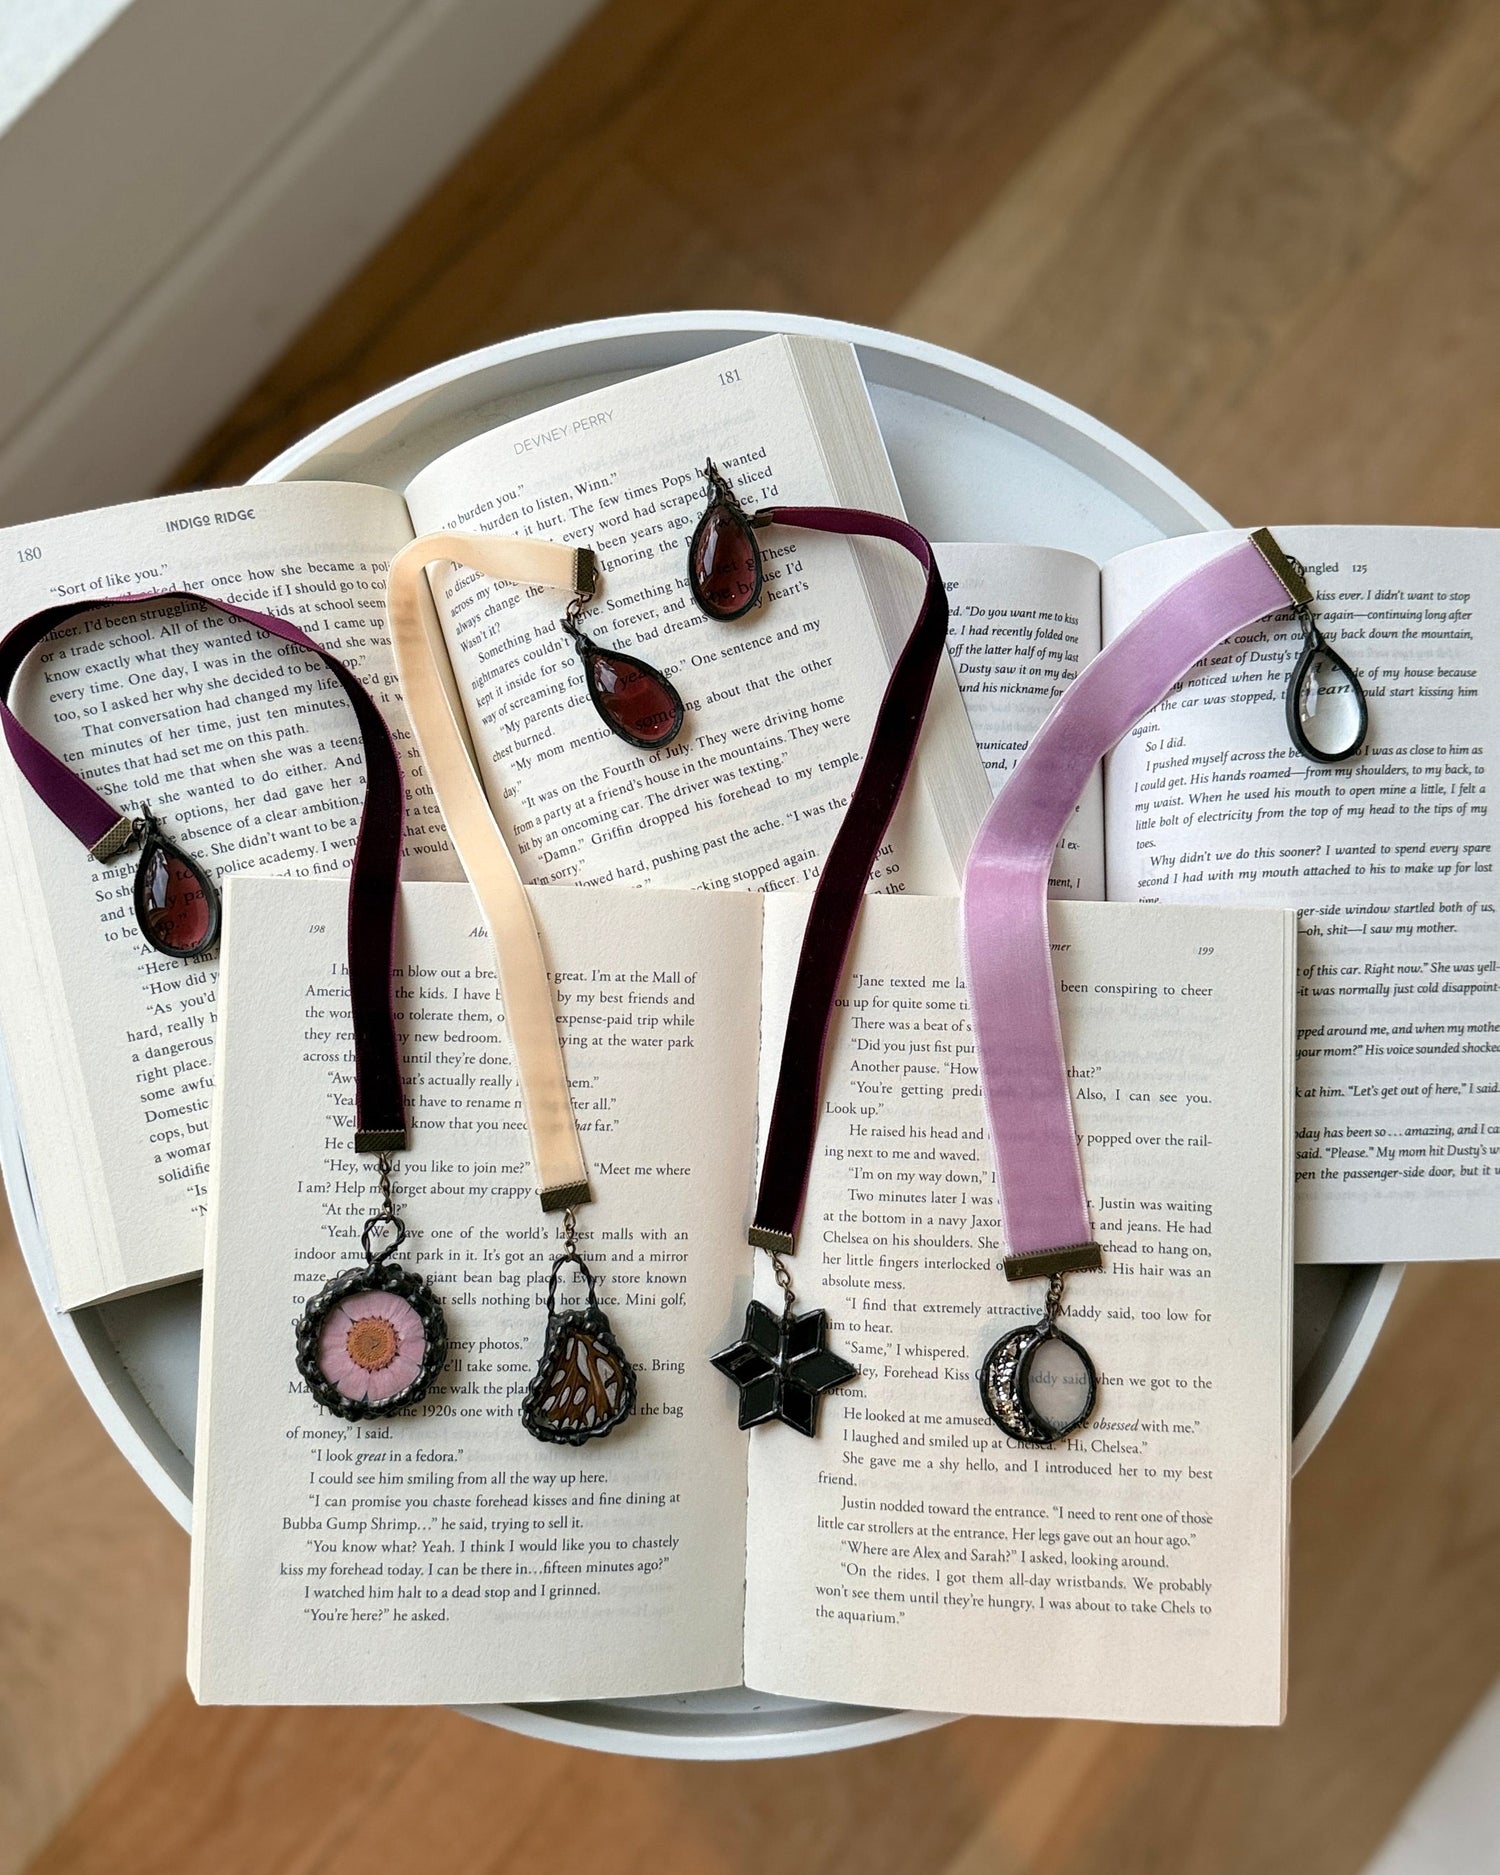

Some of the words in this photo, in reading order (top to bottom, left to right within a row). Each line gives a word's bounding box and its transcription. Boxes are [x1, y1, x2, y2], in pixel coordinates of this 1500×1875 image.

[718, 369, 742, 386] 181
[513, 425, 569, 455] DEVNEY
[572, 409, 613, 433] PERRY
[479, 511, 519, 531] burden
[521, 505, 534, 516] to
[535, 492, 573, 510] listen,
[574, 472, 617, 495] Winn.”
[568, 504, 594, 518] The
[598, 495, 619, 509] few
[624, 484, 658, 501] times
[661, 473, 691, 489] Pops
[447, 520, 457, 529] to
[457, 501, 494, 524] burden
[496, 484, 524, 508] you.”
[166, 515, 211, 533] INDIGO
[214, 509, 256, 524] RIDGE
[17, 546, 42, 563] 180
[1352, 564, 1368, 574] 125
[50, 582, 87, 597] “Sort
[89, 576, 104, 590] of
[105, 573, 131, 587] like
[134, 564, 168, 584] you.”
[227, 588, 270, 604] decide
[272, 585, 283, 597] if
[285, 584, 292, 596] I
[294, 580, 337, 594] should
[339, 582, 354, 593] go
[356, 580, 369, 590] to
[1316, 590, 1336, 601] kiss
[1338, 593, 1365, 601] ever.
[1366, 589, 1372, 600] I
[1374, 589, 1405, 600] didn’t
[1407, 592, 1434, 601] want
[1437, 592, 1448, 601] to
[1450, 592, 1471, 604] stop
[965, 606, 986, 617] “Do
[987, 609, 1008, 620] you
[1010, 610, 1037, 619] want
[1038, 612, 1053, 621] me
[1054, 613, 1063, 622] to
[1064, 613, 1078, 626] kiss
[691, 653, 717, 667] One
[720, 635, 773, 658] sentence
[776, 624, 799, 641] and
[802, 619, 820, 632] my
[949, 643, 965, 658] off
[965, 643, 982, 655] the
[984, 644, 1013, 655] latter
[1014, 645, 1036, 659] half
[1036, 647, 1048, 660] of
[1048, 651, 1063, 663] my
[1064, 650, 1079, 663] last
[54, 711, 81, 723] too,
[83, 706, 98, 717] so
[100, 701, 108, 713] I
[111, 692, 149, 711] asked
[151, 689, 174, 702] her
[177, 683, 203, 696] why
[207, 678, 230, 690] she
[233, 665, 285, 685] decided
[287, 665, 302, 675] to
[304, 661, 321, 672] be
[81, 722, 114, 737] That
[118, 705, 202, 730] conversation
[204, 696, 231, 711] had
[234, 685, 290, 705] changed
[293, 684, 313, 696] my
[1131, 721, 1160, 738] again.
[123, 756, 151, 770] that
[153, 748, 178, 764] had
[181, 745, 201, 758] set
[203, 741, 224, 753] me
[227, 737, 245, 748] on
[247, 731, 273, 744] this
[275, 724, 309, 742] path.
[522, 797, 536, 808] “It
[538, 789, 559, 802] was
[562, 782, 577, 793] on
[580, 774, 600, 787] the
[601, 757, 645, 779] Fourth
[649, 752, 663, 764] of
[664, 743, 693, 763] July.
[695, 732, 727, 748] They
[731, 722, 761, 737] were
[764, 707, 809, 727] driving
[810, 695, 845, 713] home
[1145, 741, 1157, 752] So
[1160, 739, 1164, 750] I
[1166, 736, 1186, 749] did.
[1134, 782, 1138, 793] I
[1140, 777, 1166, 792] could
[1168, 777, 1187, 791] get.
[1190, 773, 1209, 785] His
[1212, 769, 1246, 782] hands
[1335, 768, 1353, 779] my
[1355, 764, 1409, 776] shoulders,
[1412, 766, 1423, 775] to
[1425, 767, 1442, 778] my
[1444, 763, 1472, 776] back,
[1474, 765, 1485, 774] to
[1136, 840, 1156, 850] toes.
[1345, 903, 1391, 915] window
[1393, 902, 1435, 914] startled
[1438, 901, 1463, 913] both
[1466, 901, 1479, 916] of
[1480, 904, 1496, 913] us,
[309, 924, 326, 934] 198
[1198, 947, 1215, 956] 199
[554, 973, 587, 984] great.
[591, 969, 611, 982] I’m
[615, 974, 626, 982] at
[630, 970, 649, 983] the
[652, 971, 680, 983] Mall
[684, 971, 698, 984] of
[1303, 964, 1316, 980] of
[1317, 964, 1338, 976] this
[1340, 967, 1361, 975] car.
[1363, 963, 1395, 978] Right
[1397, 962, 1429, 974] now.”
[1431, 962, 1451, 974] She
[1453, 964, 1475, 973] was
[1061, 980, 1088, 993] been
[1094, 983, 1158, 999] conspiring
[1163, 987, 1175, 995] to
[1181, 983, 1213, 996] cheer
[826, 1102, 857, 1114] Look
[860, 1102, 884, 1119] up.”
[311, 1449, 322, 1461] “I
[326, 1448, 353, 1462] look
[354, 1452, 387, 1466] great
[389, 1450, 402, 1462] in
[405, 1453, 412, 1462] a
[416, 1449, 464, 1462] fedora.”
[818, 1470, 857, 1486] friend.
[841, 1540, 888, 1556] “Where
[891, 1548, 910, 1557] are
[912, 1545, 941, 1561] Alex
[944, 1547, 967, 1561] and
[970, 1548, 1017, 1563] Sarah?”
[1021, 1550, 1026, 1564] I
[1029, 1550, 1067, 1565] asked,
[1071, 1551, 1119, 1570] looking
[1121, 1555, 1169, 1568] around.
[304, 1608, 349, 1621] “You’re
[350, 1608, 390, 1621] here?”
[393, 1608, 408, 1621] he
[411, 1608, 449, 1621] asked.
[816, 1604, 835, 1618] the
[838, 1610, 905, 1624] aquarium.”
